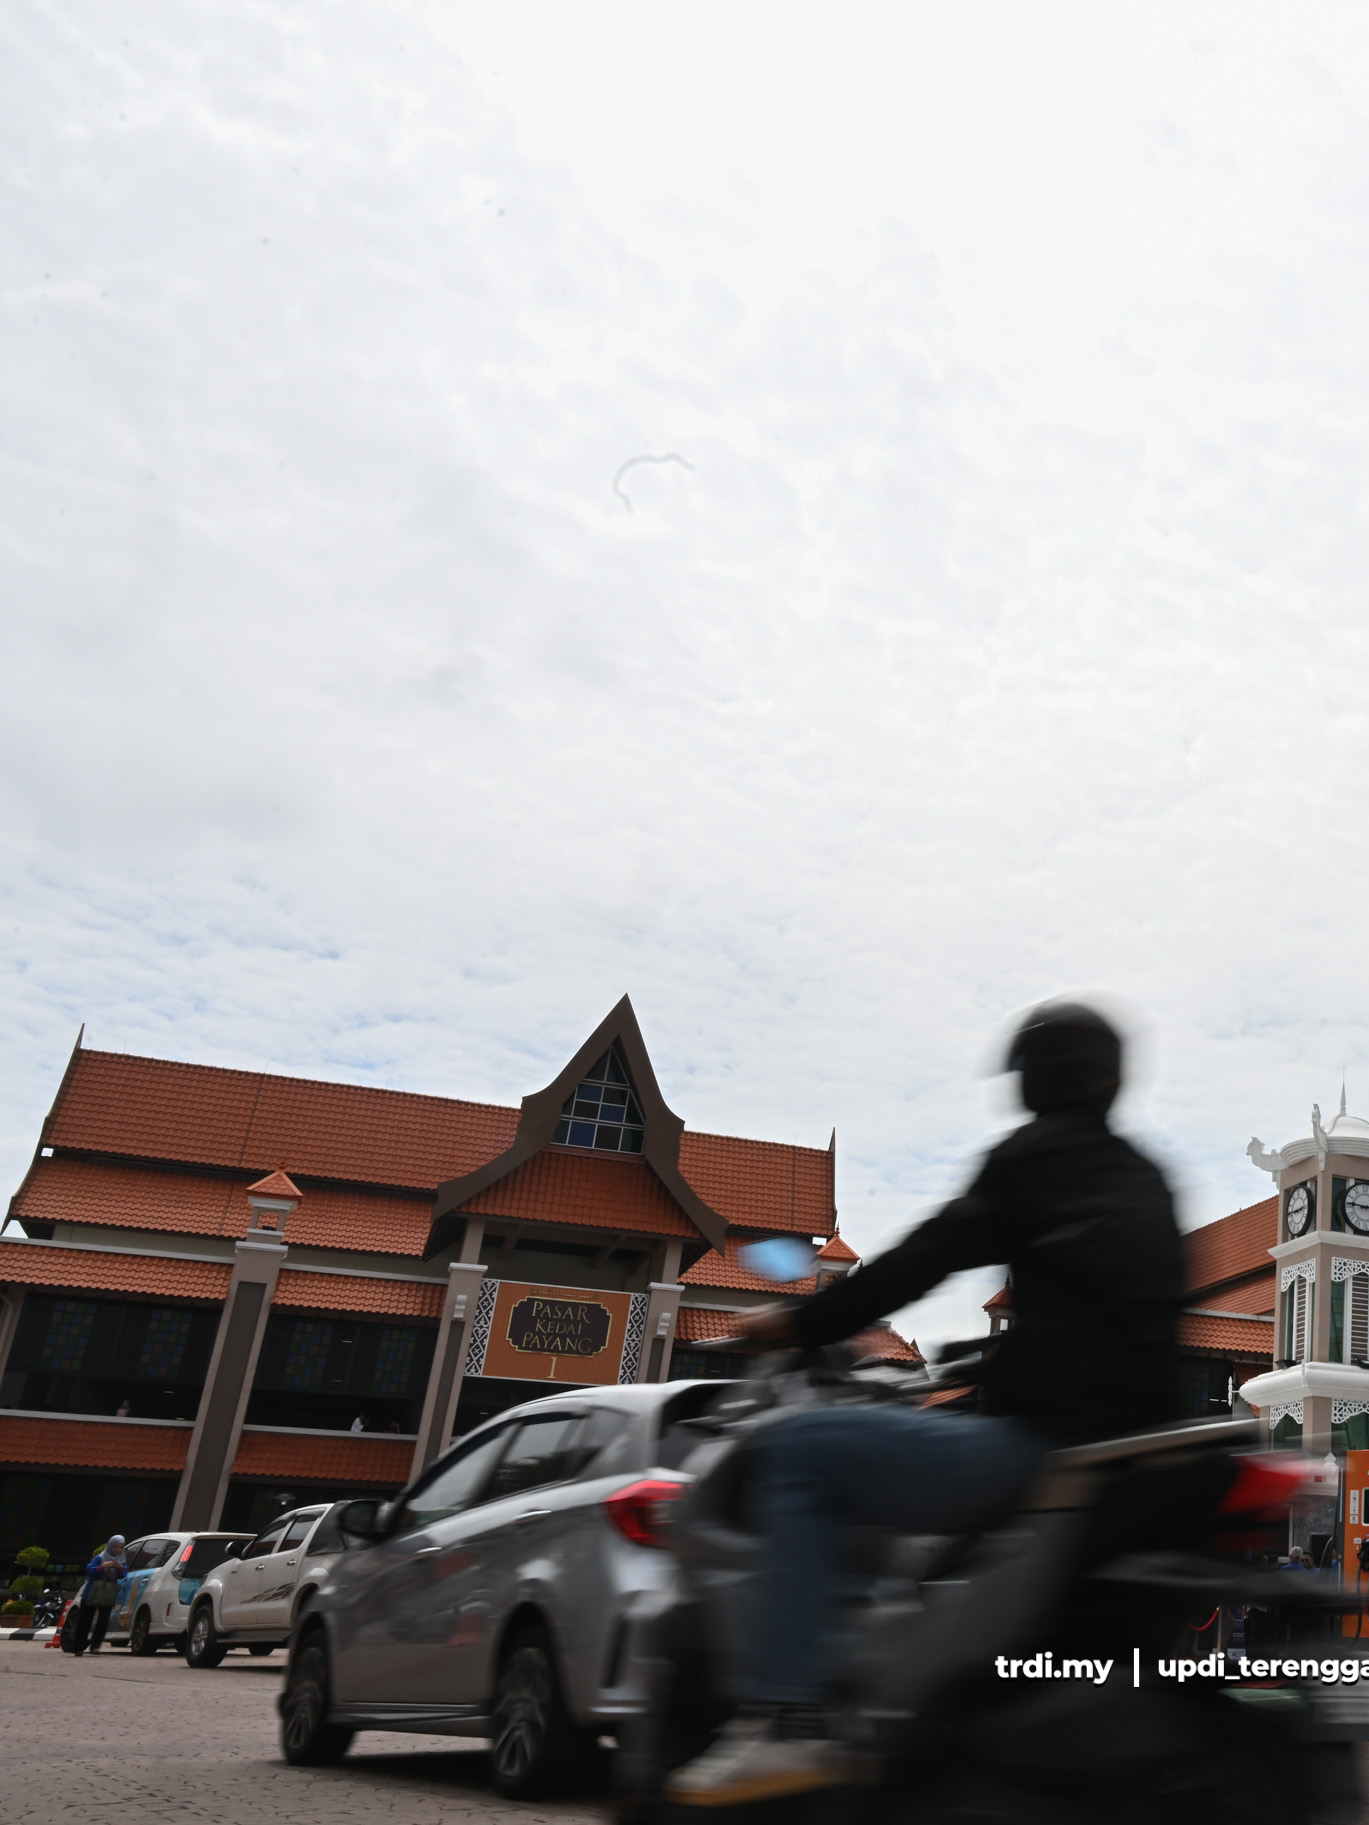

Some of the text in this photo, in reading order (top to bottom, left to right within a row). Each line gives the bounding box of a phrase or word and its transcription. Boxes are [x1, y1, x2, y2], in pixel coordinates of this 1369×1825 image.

[531, 1301, 591, 1324] PASAR
[535, 1319, 582, 1336] KEDAI
[522, 1331, 593, 1354] PAYANG
[546, 1356, 557, 1379] 1
